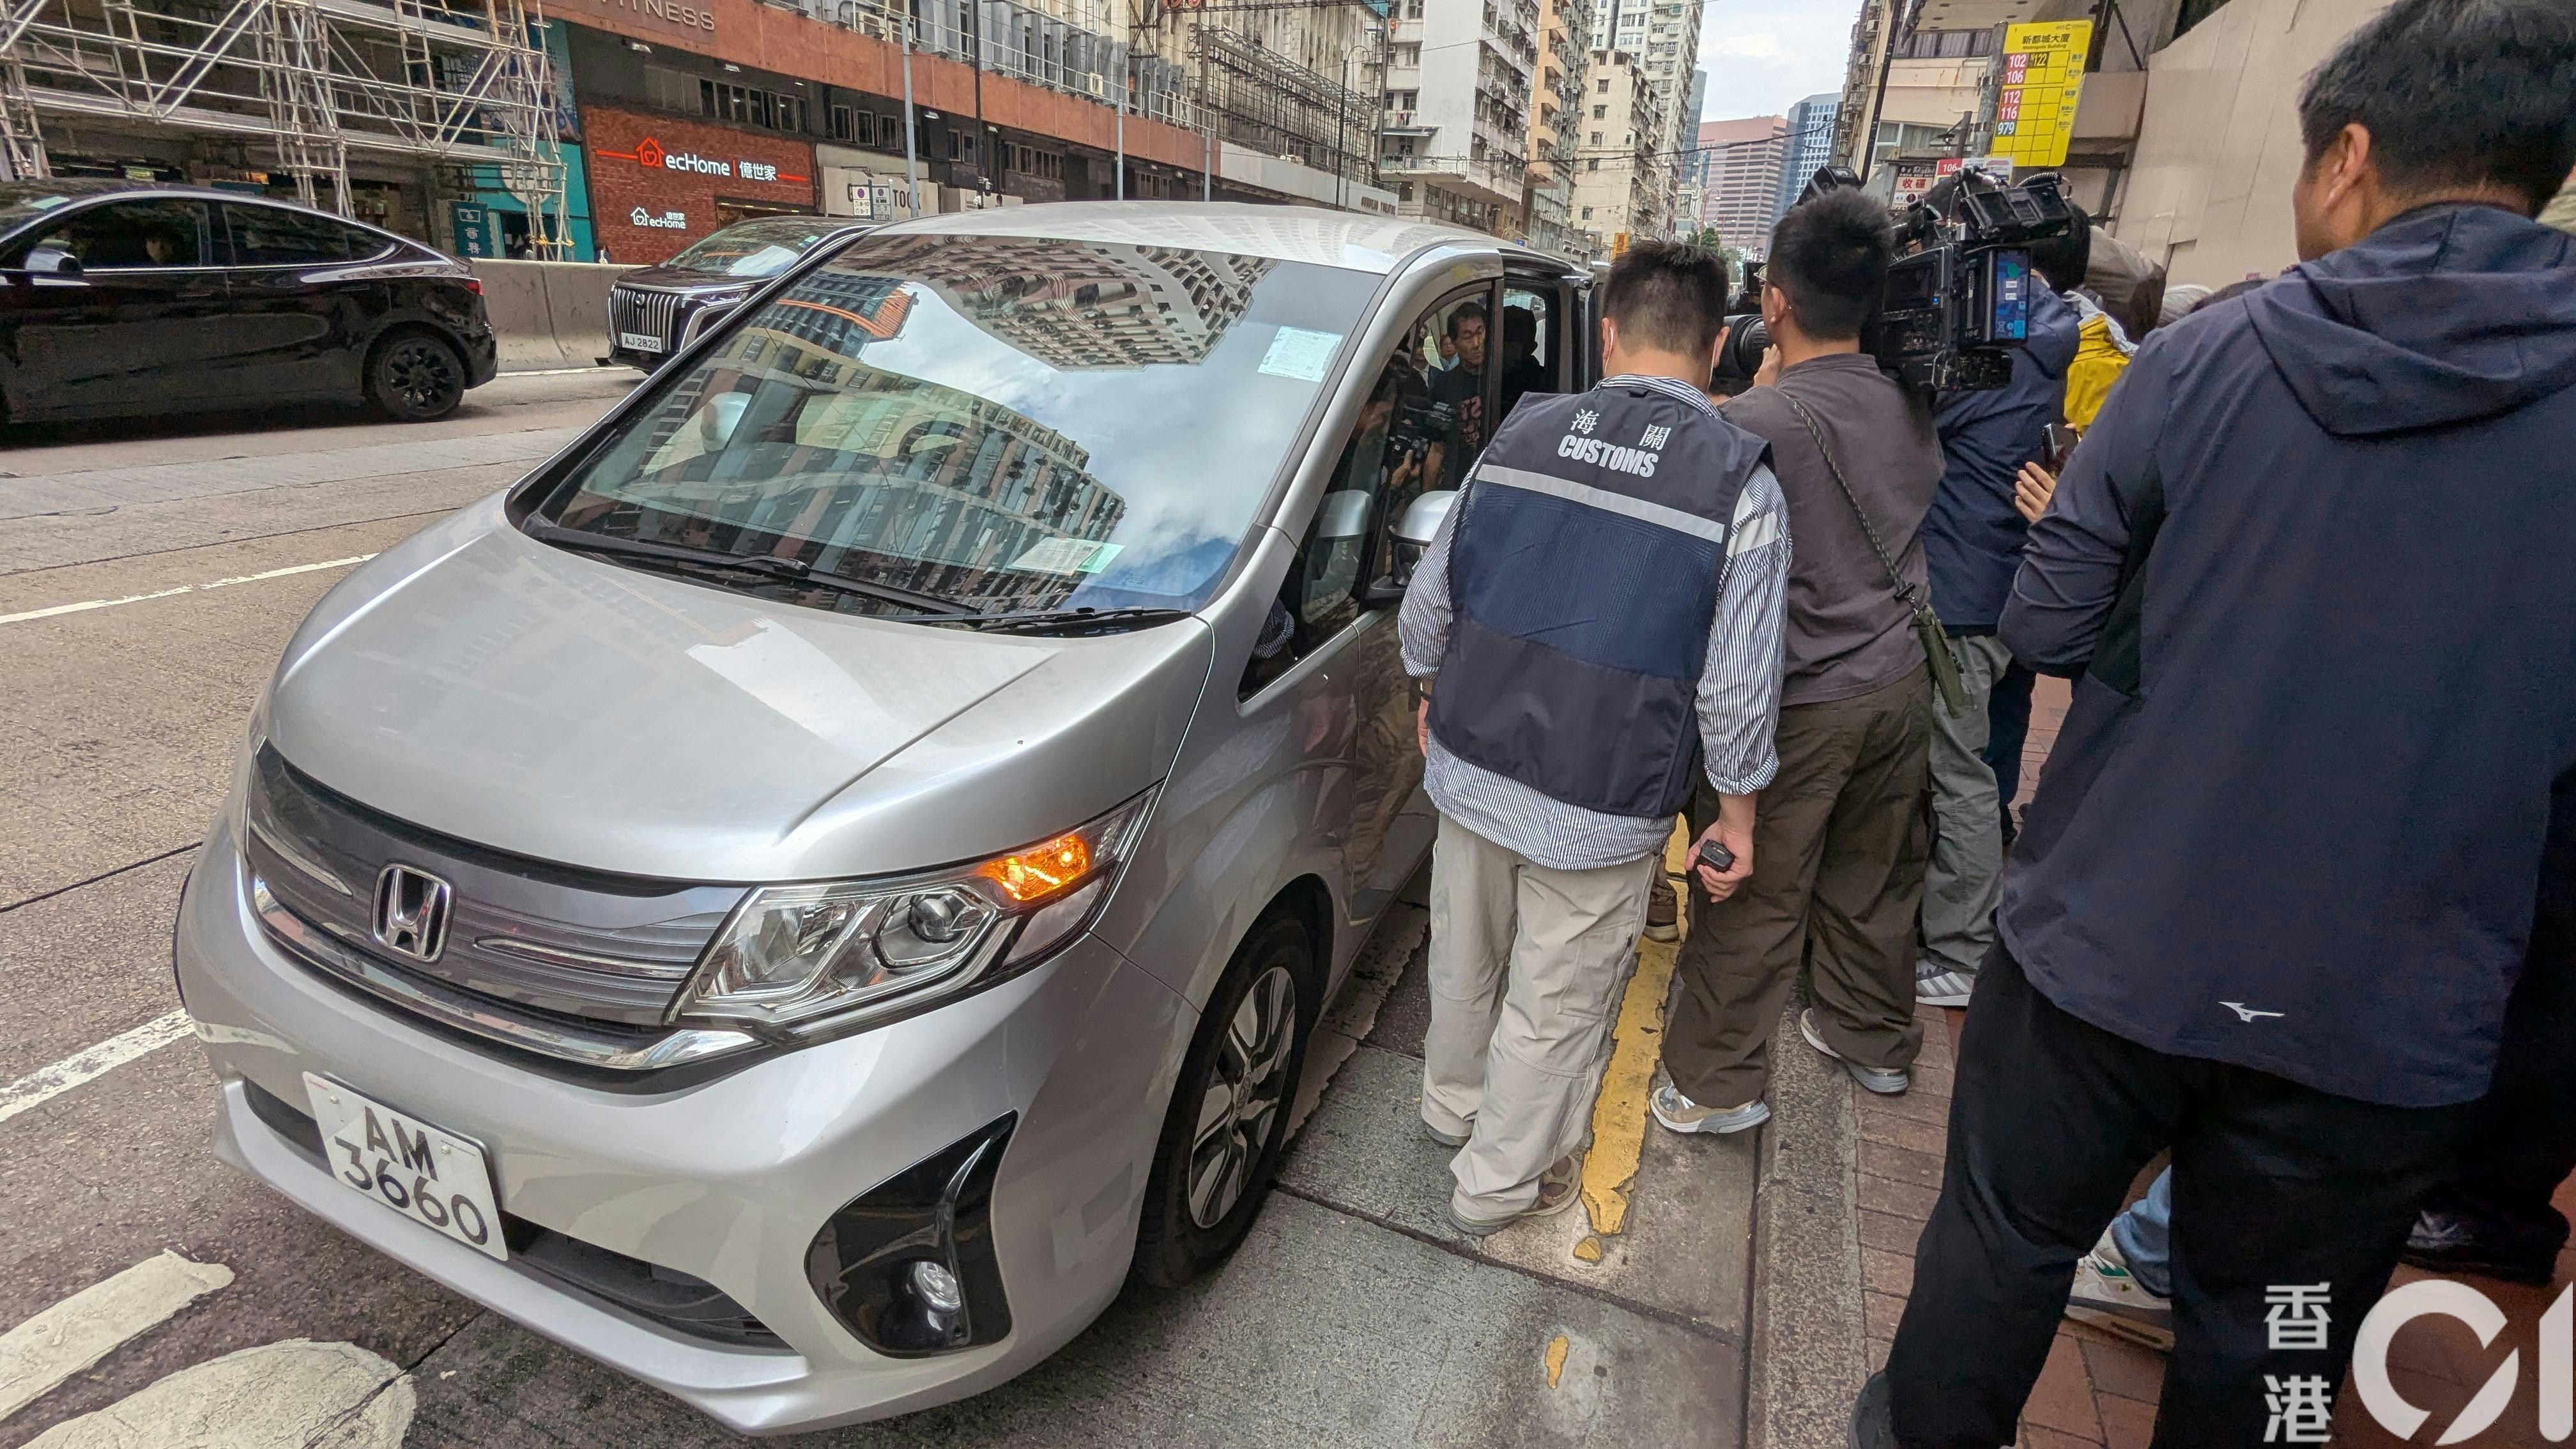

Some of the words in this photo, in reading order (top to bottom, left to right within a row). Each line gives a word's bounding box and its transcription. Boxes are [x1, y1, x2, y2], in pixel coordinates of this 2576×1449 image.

[2009, 54, 2027, 68] 102
[2007, 72, 2023, 84] 106
[2004, 90, 2021, 104] 112
[2000, 106, 2018, 120] 116
[1998, 121, 2014, 135] 979
[666, 153, 730, 176] ecHome
[739, 161, 777, 181] 億世家
[650, 217, 686, 229] ecHome
[624, 336, 635, 346] AJ
[637, 338, 659, 349] 2822
[1570, 408, 1672, 451] 海關
[1557, 434, 1659, 478] CUSTOMS
[364, 1105, 439, 1182] AM
[334, 1135, 488, 1246] 3660
